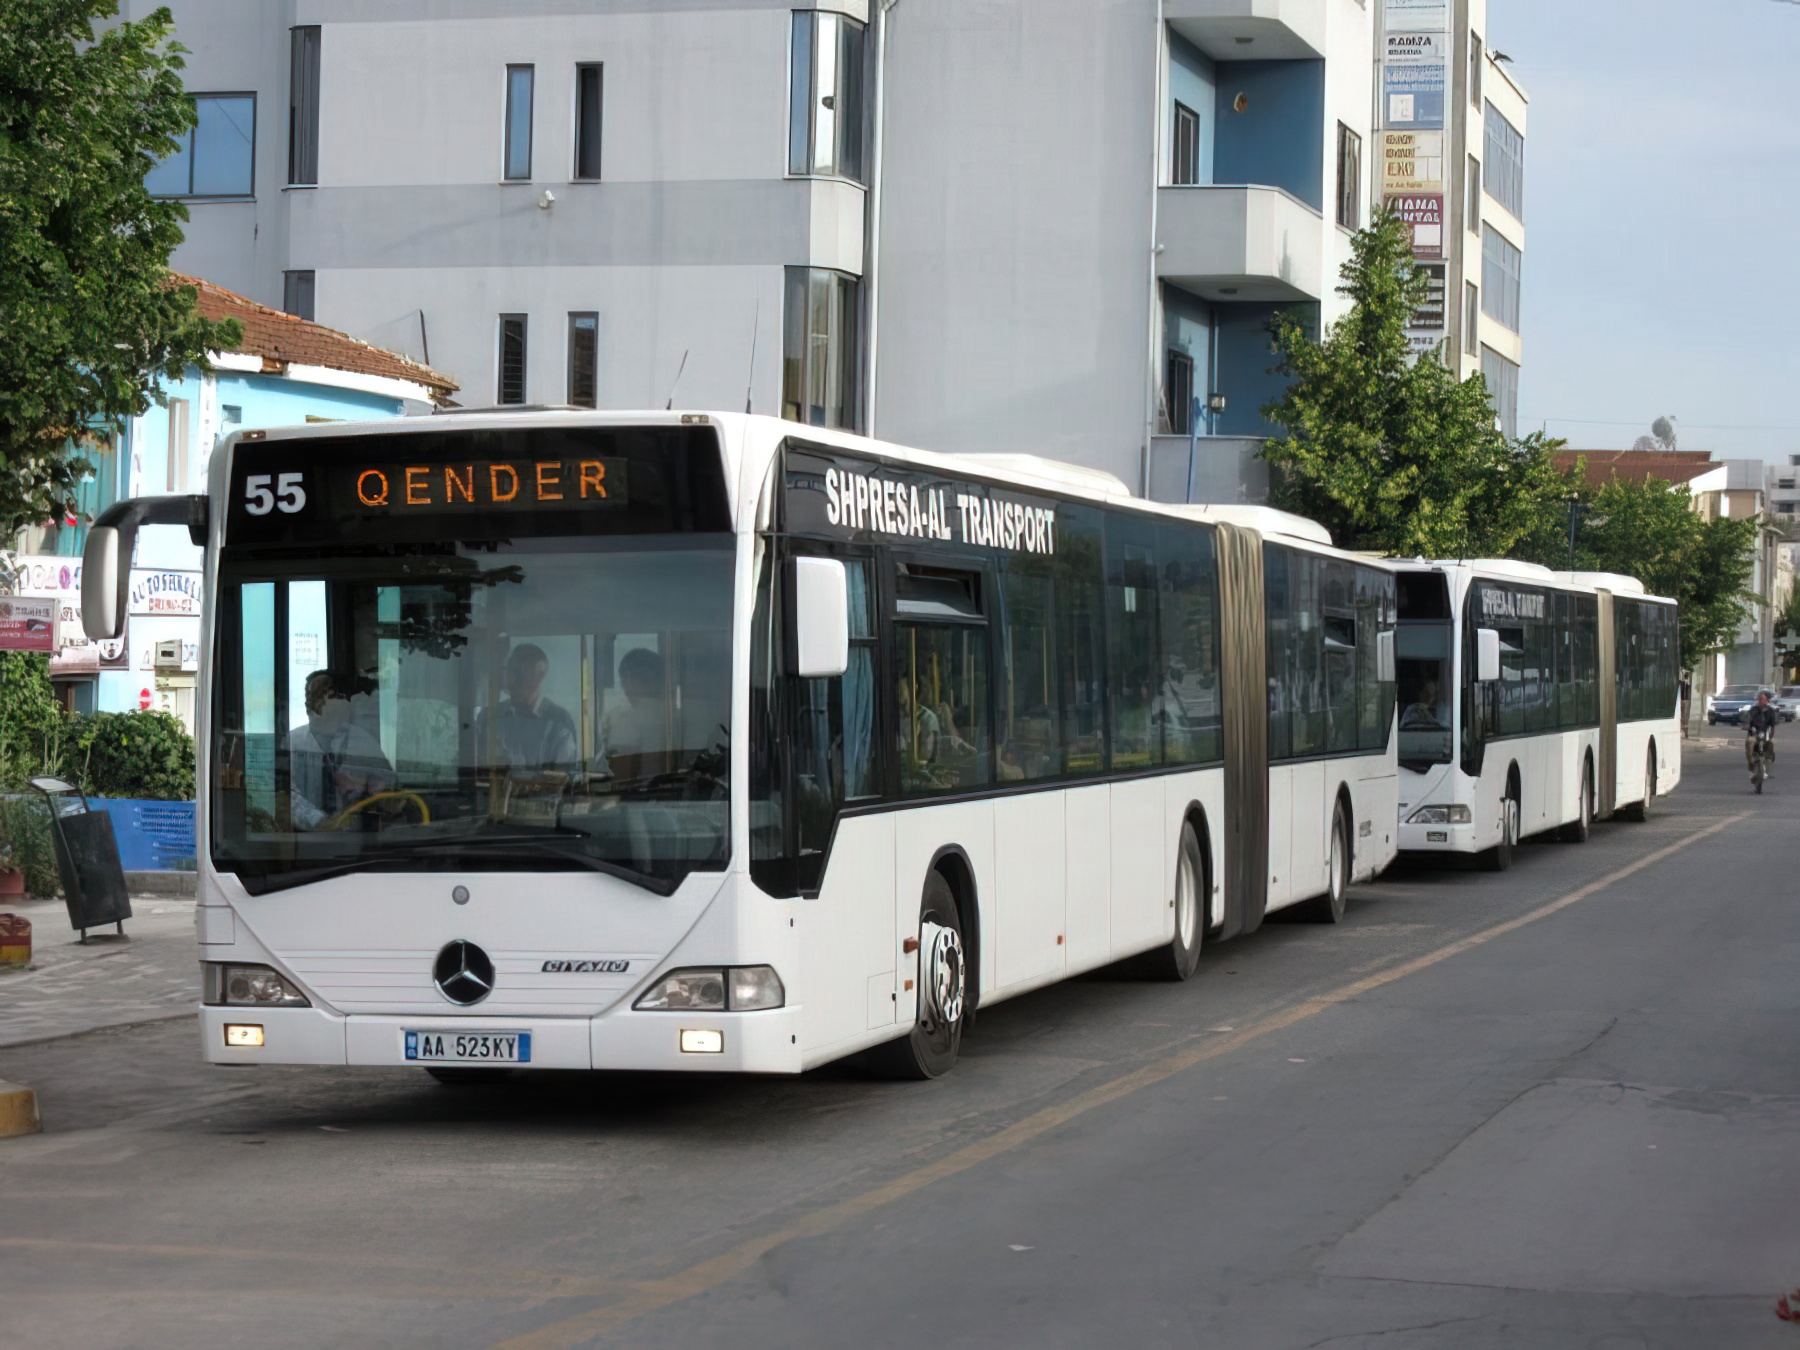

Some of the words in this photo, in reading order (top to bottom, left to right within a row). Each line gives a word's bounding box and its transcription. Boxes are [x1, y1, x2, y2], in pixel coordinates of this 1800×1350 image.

[245, 472, 307, 516] 55
[357, 460, 607, 507] QENDER
[825, 468, 951, 541] SHPRESA-AL
[957, 494, 1054, 554] TRANSPORT
[422, 1035, 445, 1057] AA
